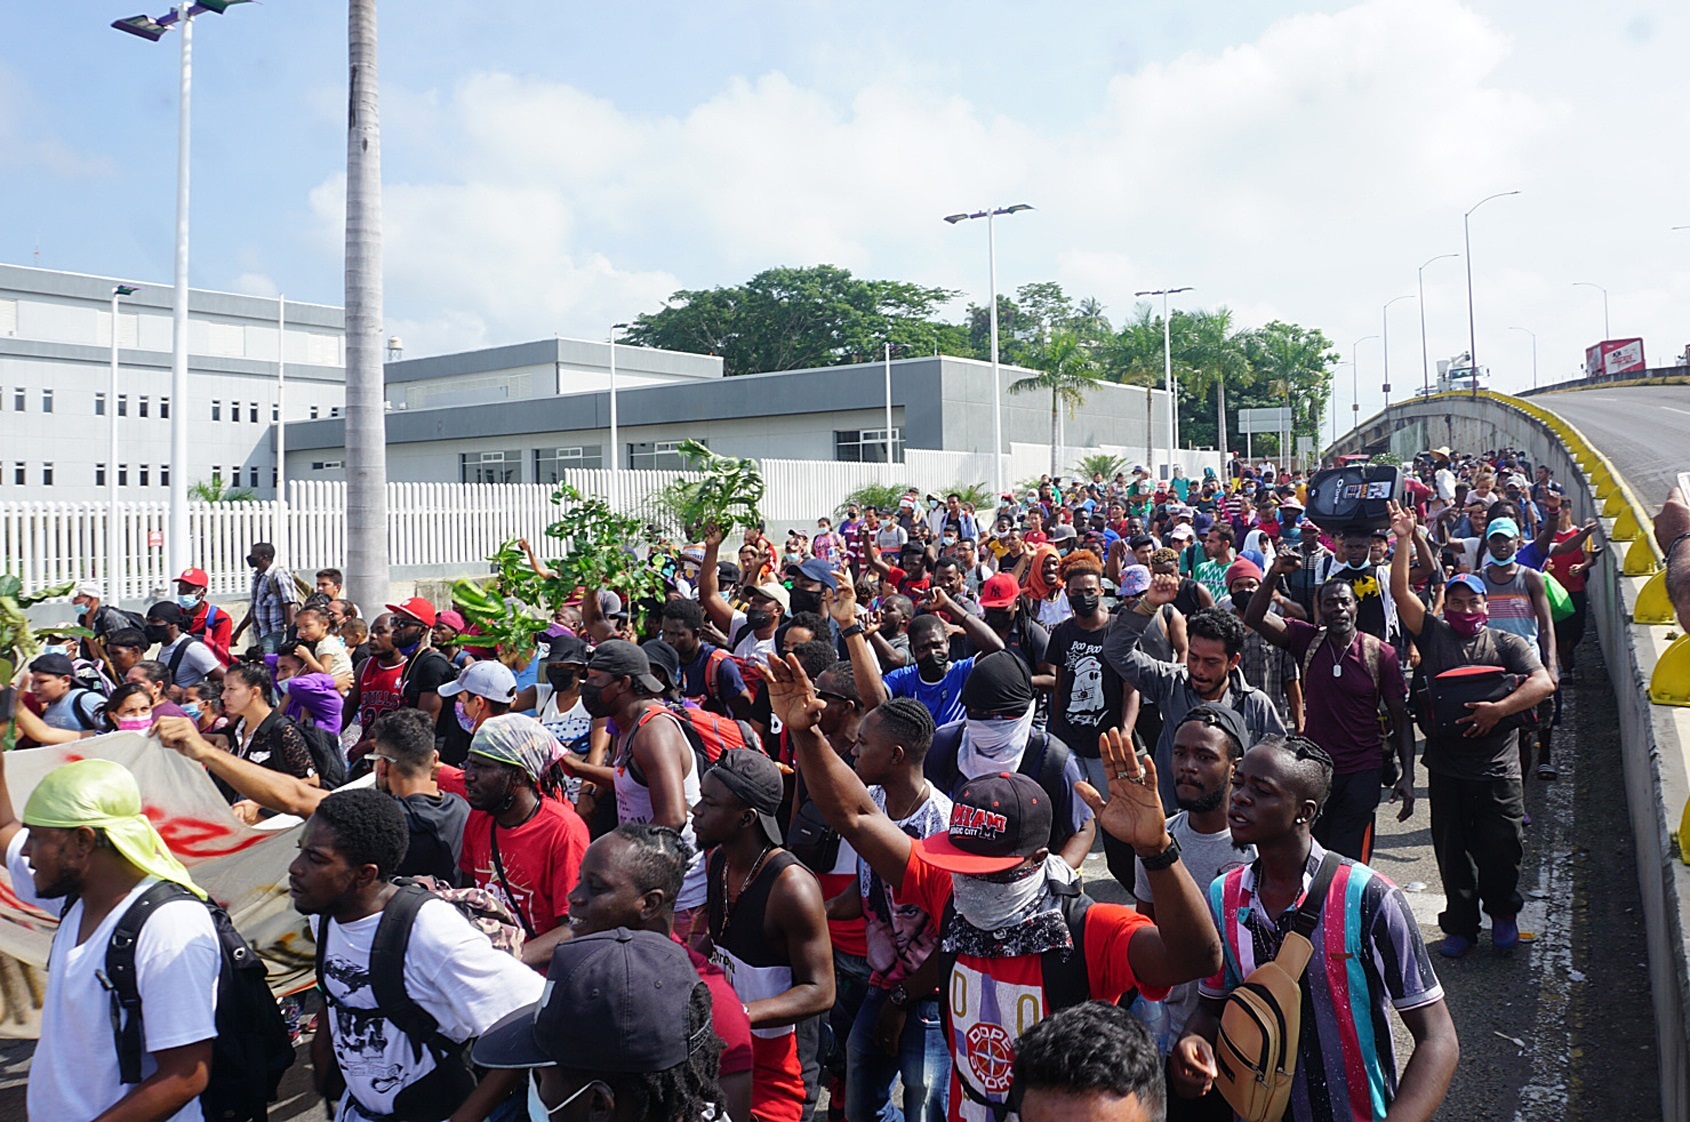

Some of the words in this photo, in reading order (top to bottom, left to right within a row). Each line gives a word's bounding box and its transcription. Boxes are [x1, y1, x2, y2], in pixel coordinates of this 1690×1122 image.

[361, 691, 400, 708] BULLS
[949, 802, 1008, 833] MIAMI
[964, 827, 978, 836] CITY
[968, 1026, 1012, 1053] DOPE
